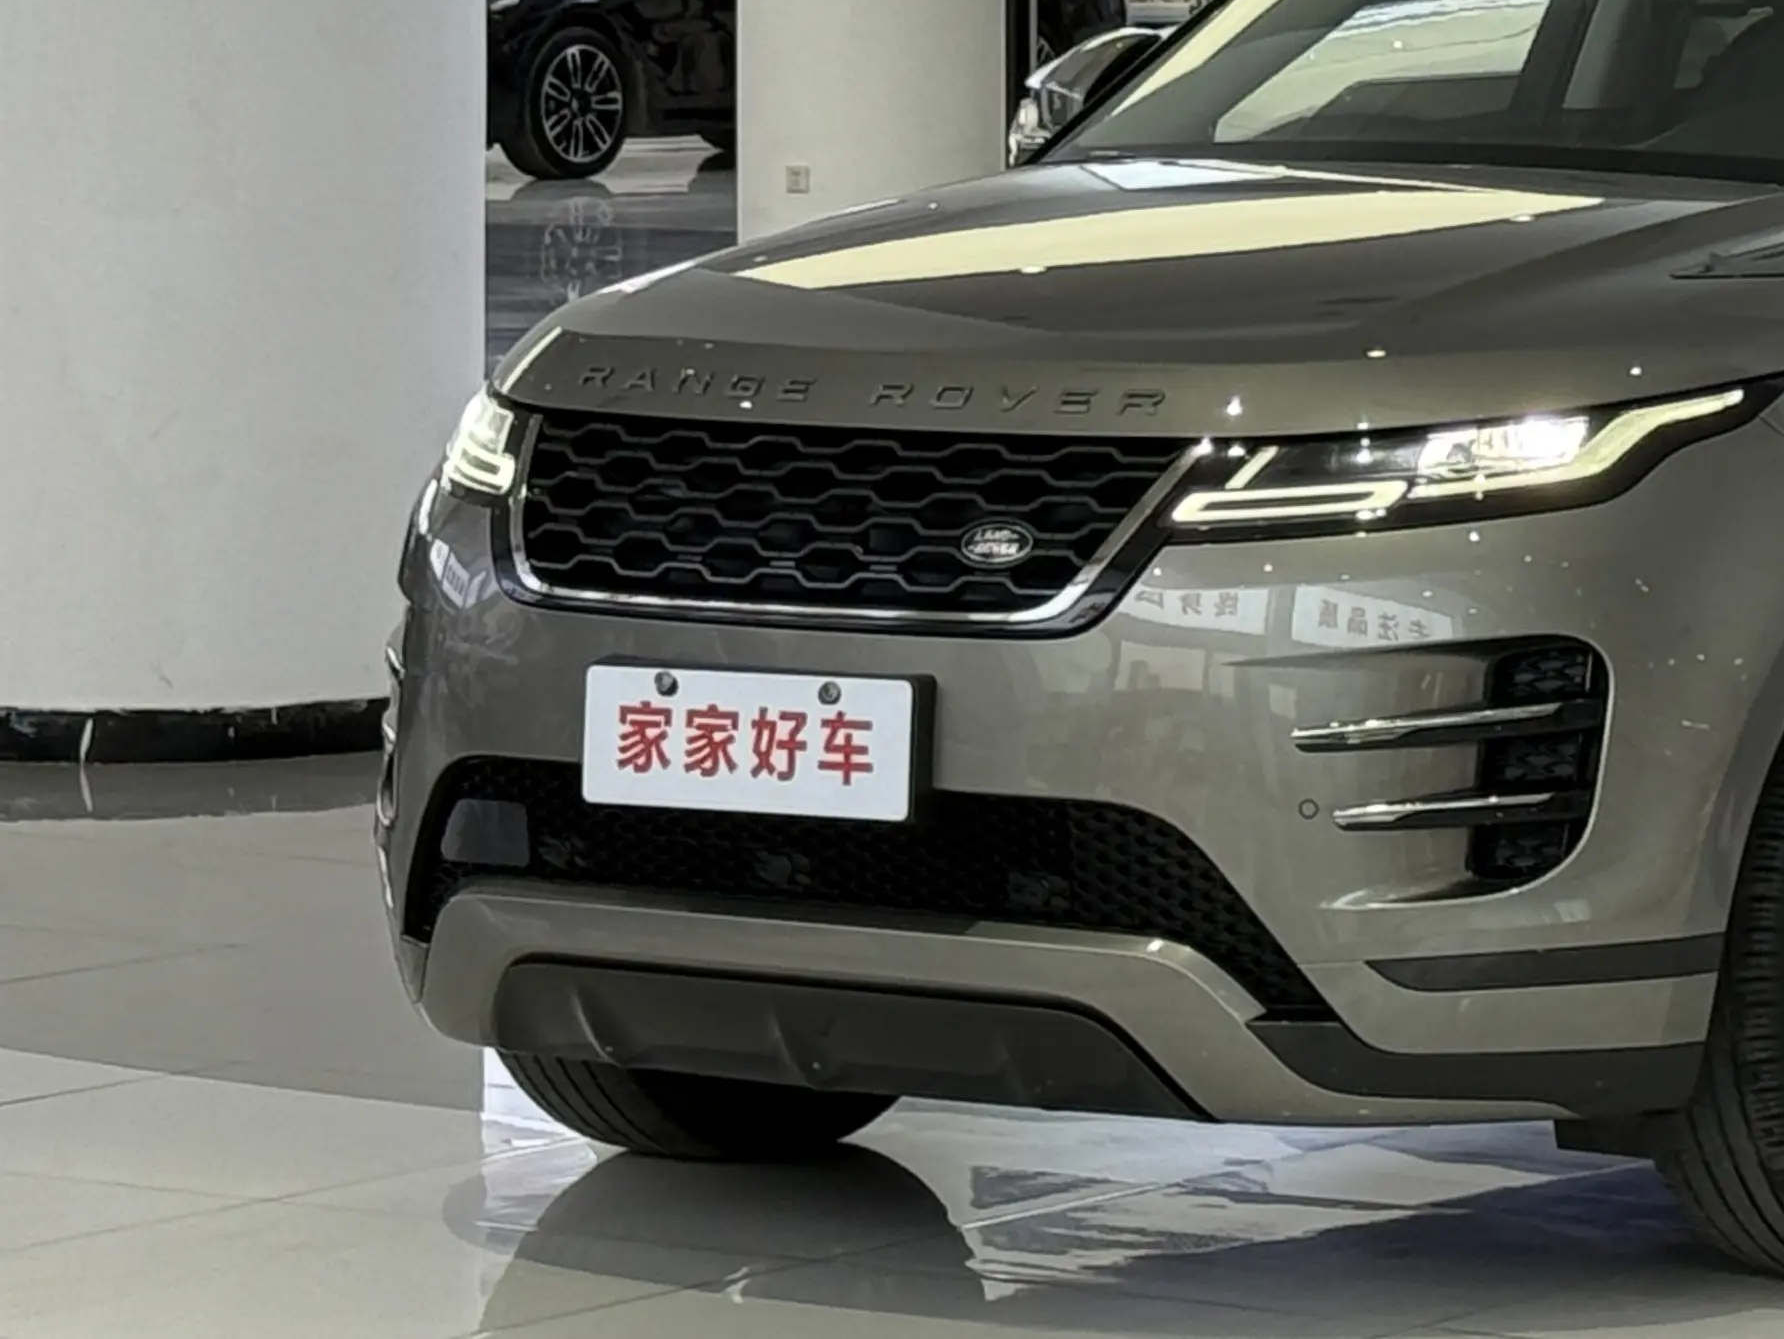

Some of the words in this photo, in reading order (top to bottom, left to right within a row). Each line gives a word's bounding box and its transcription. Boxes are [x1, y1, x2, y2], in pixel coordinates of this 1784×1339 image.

[578, 364, 818, 402] RANGE
[869, 383, 1167, 417] ROVER
[616, 700, 874, 786] 家家好车
